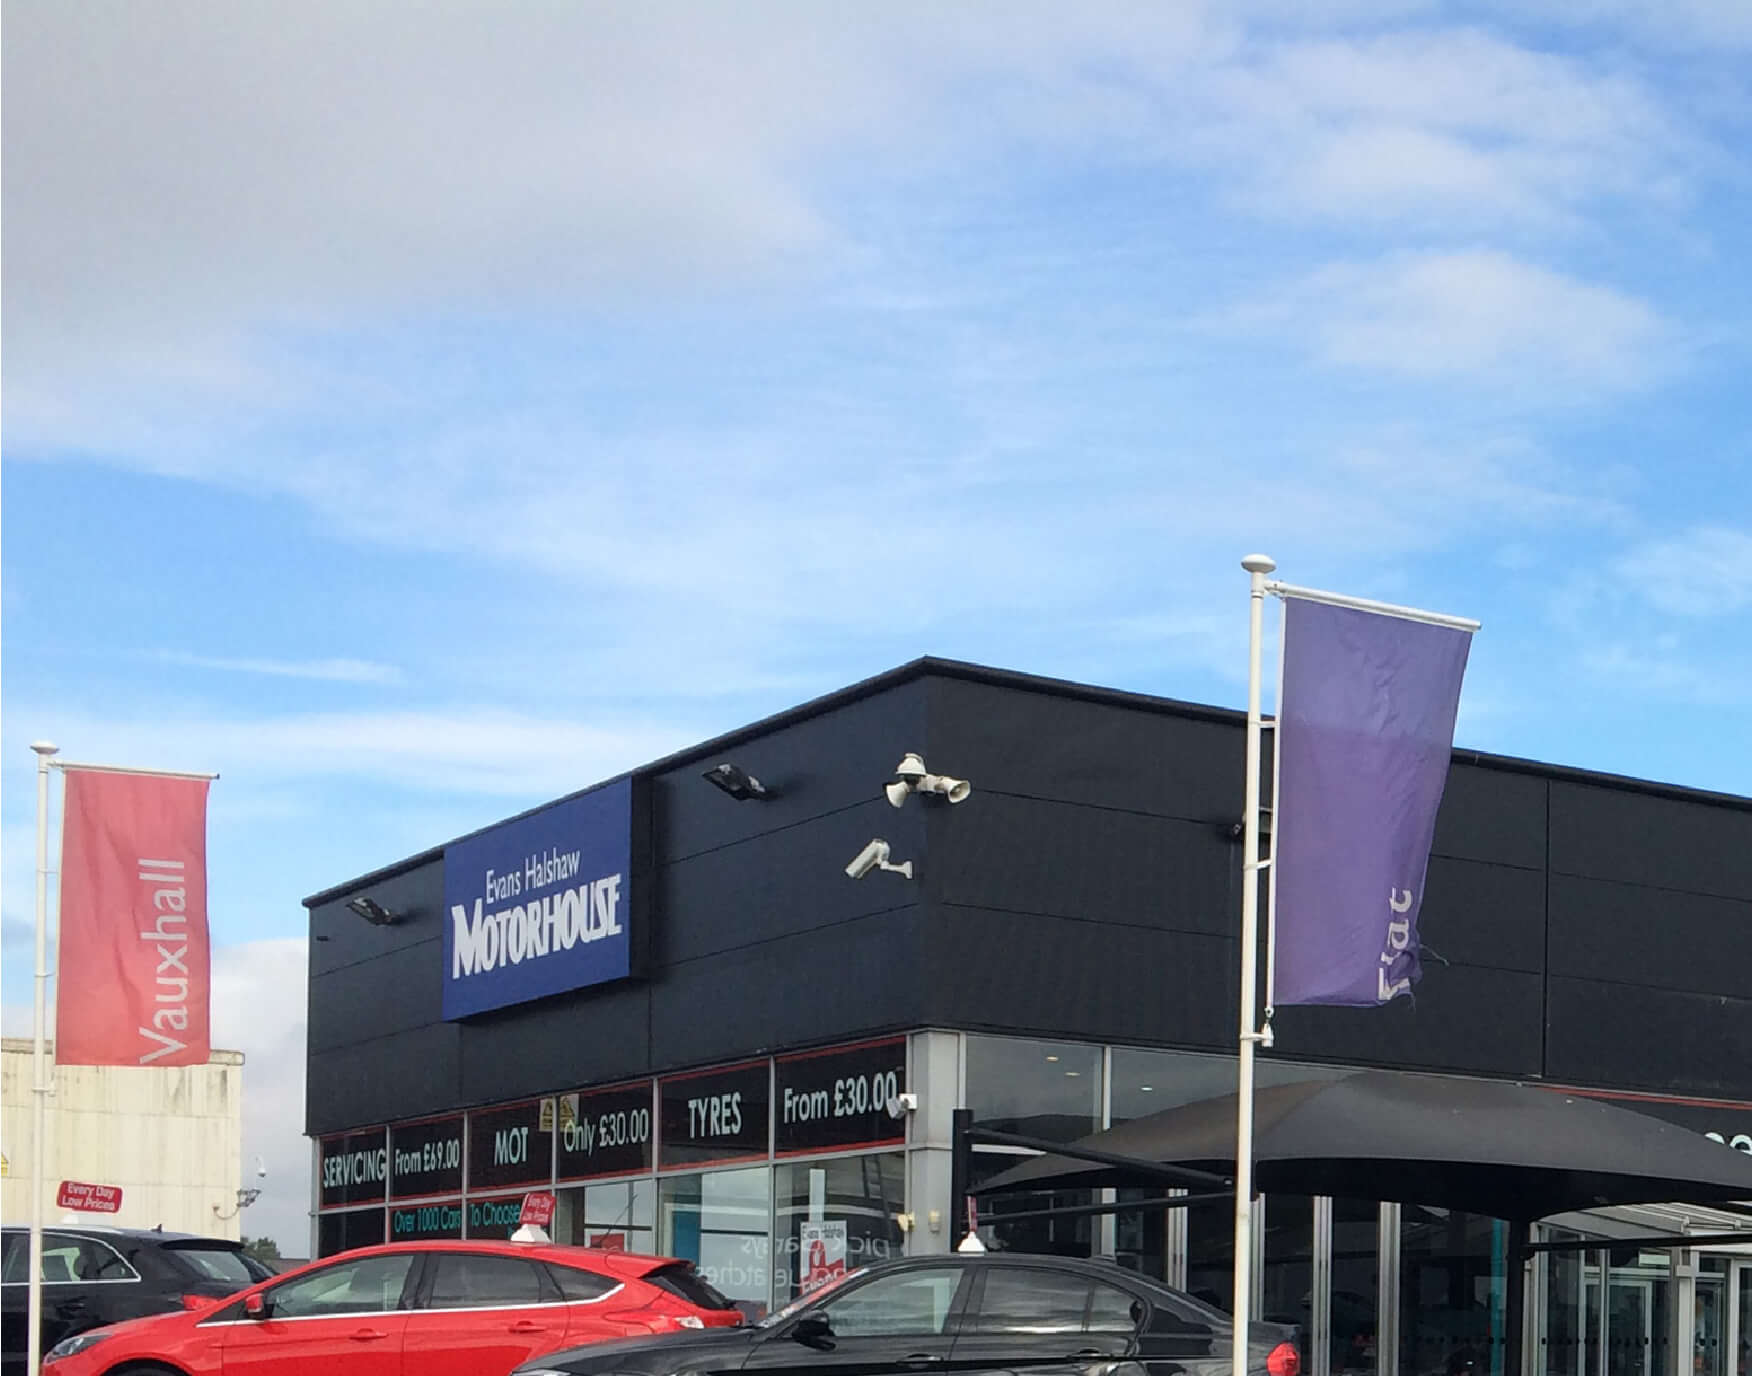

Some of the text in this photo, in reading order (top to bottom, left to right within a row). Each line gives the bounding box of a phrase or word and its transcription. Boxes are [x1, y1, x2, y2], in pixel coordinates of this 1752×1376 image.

[486, 847, 581, 904] Evans Halshaw
[451, 872, 622, 980] MOTORHOUSE
[137, 858, 188, 1065] Vauxhall
[687, 1091, 742, 1139] TYRES
[783, 1071, 897, 1124] From £30.00
[495, 1126, 528, 1167] MOT
[563, 1108, 649, 1157] Only £30.00
[323, 1149, 386, 1189] SERVICING
[395, 1138, 461, 1177] From £69.00
[394, 1205, 462, 1233] Over 1000 Cars
[470, 1201, 521, 1227] To Choose
